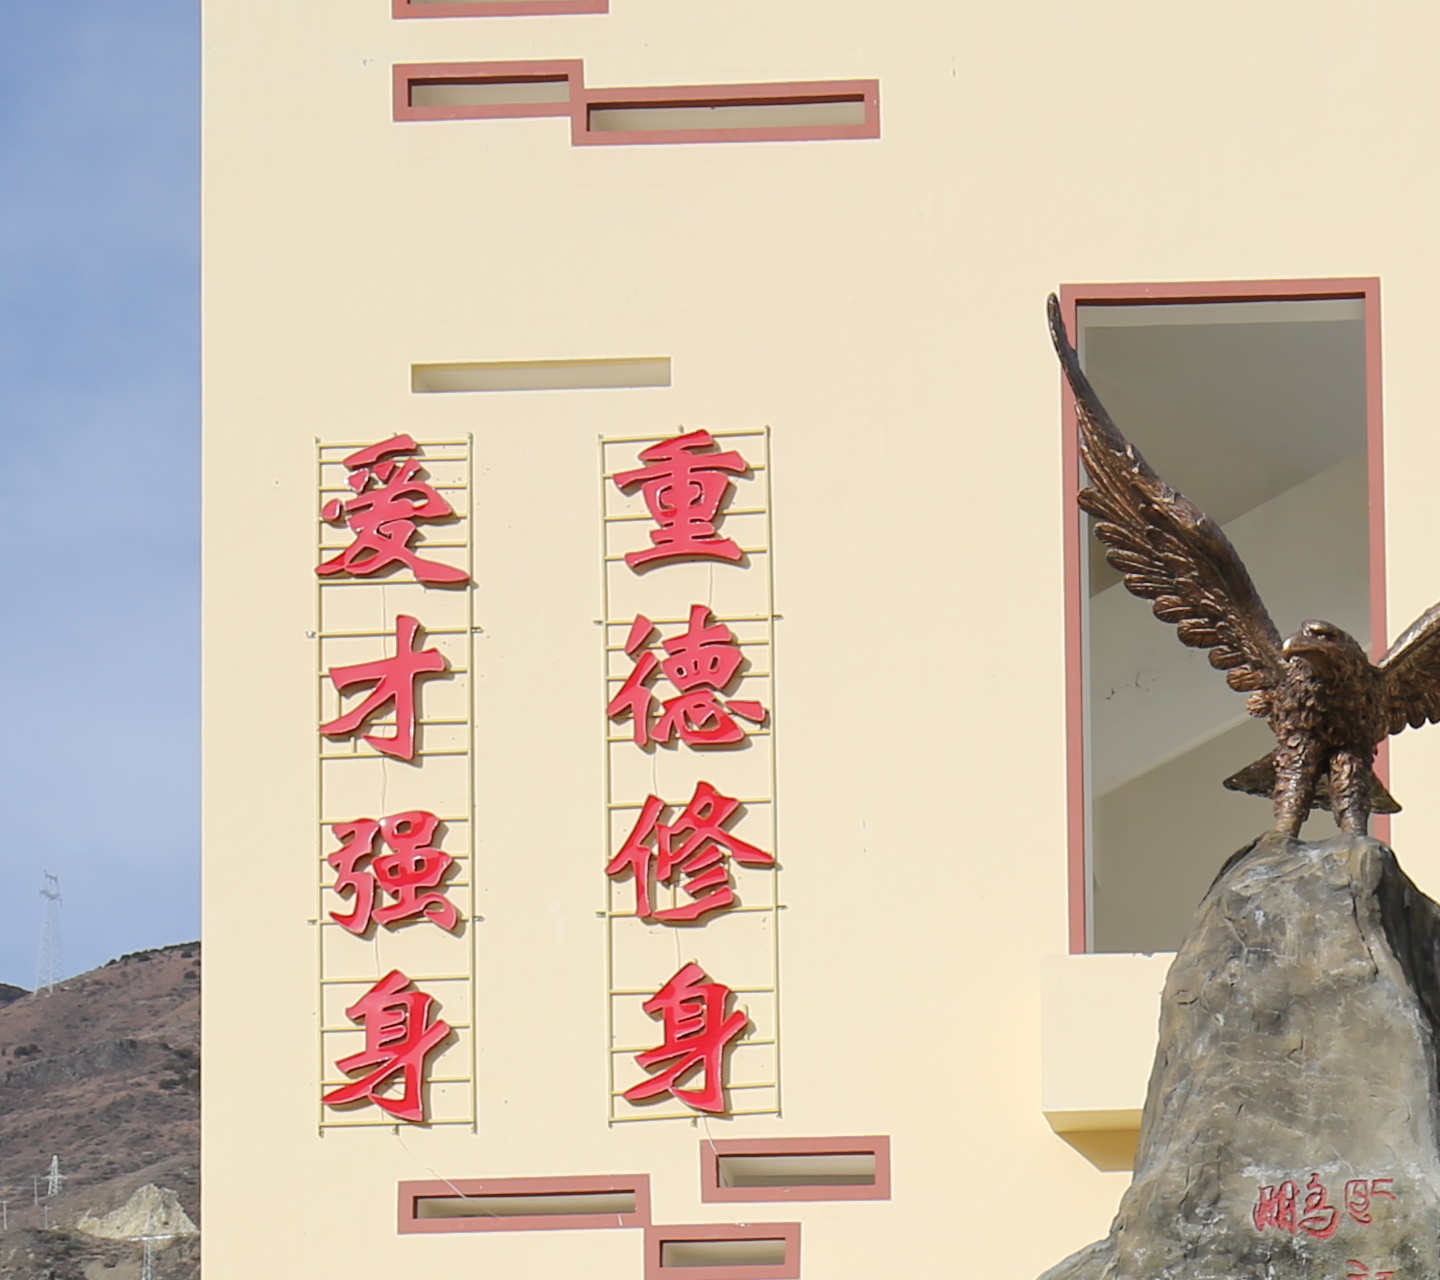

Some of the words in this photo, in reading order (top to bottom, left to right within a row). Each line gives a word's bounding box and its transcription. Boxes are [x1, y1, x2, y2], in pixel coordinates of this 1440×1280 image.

[315, 434, 471, 1122] 爱才强身
[605, 429, 777, 1113] 重德修身
